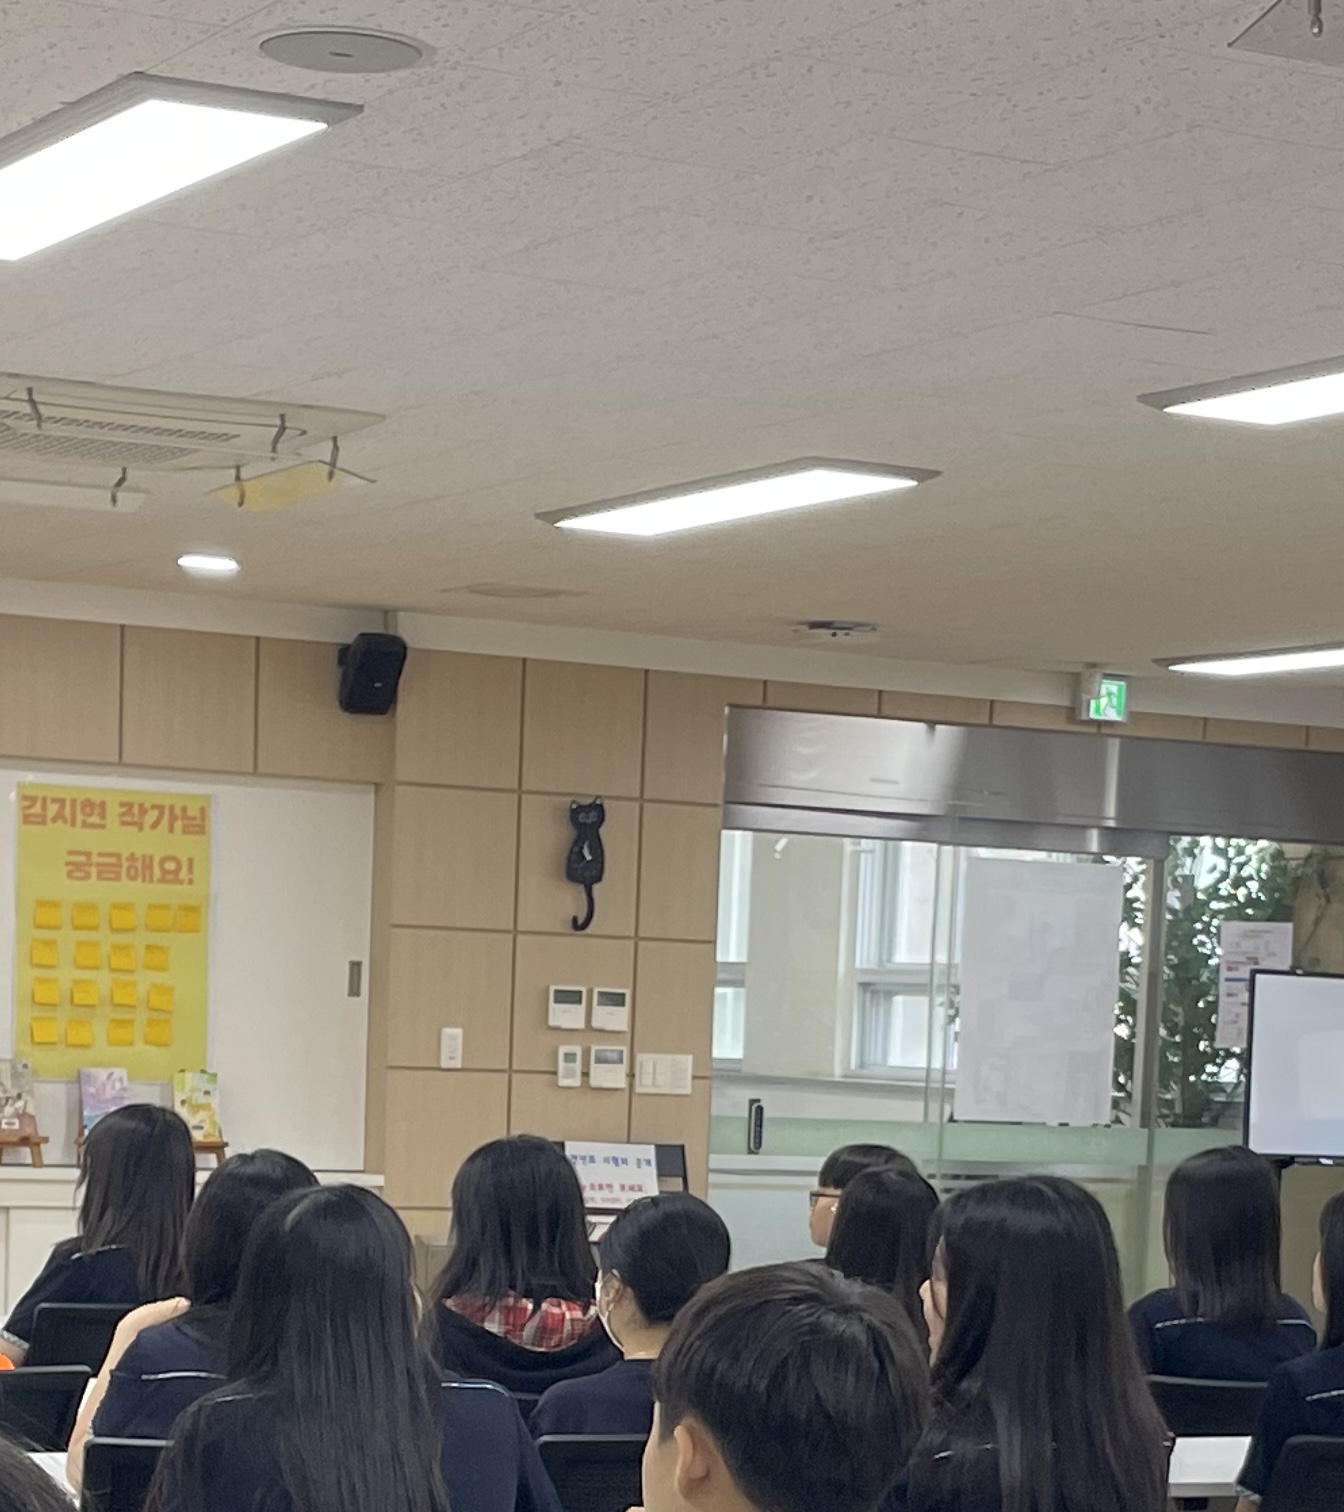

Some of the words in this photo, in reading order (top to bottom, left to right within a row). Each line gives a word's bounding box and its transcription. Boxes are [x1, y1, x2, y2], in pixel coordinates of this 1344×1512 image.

[20, 794, 106, 830] 김지현
[118, 801, 206, 836] 작가님
[64, 849, 194, 885] 궁금해요!
